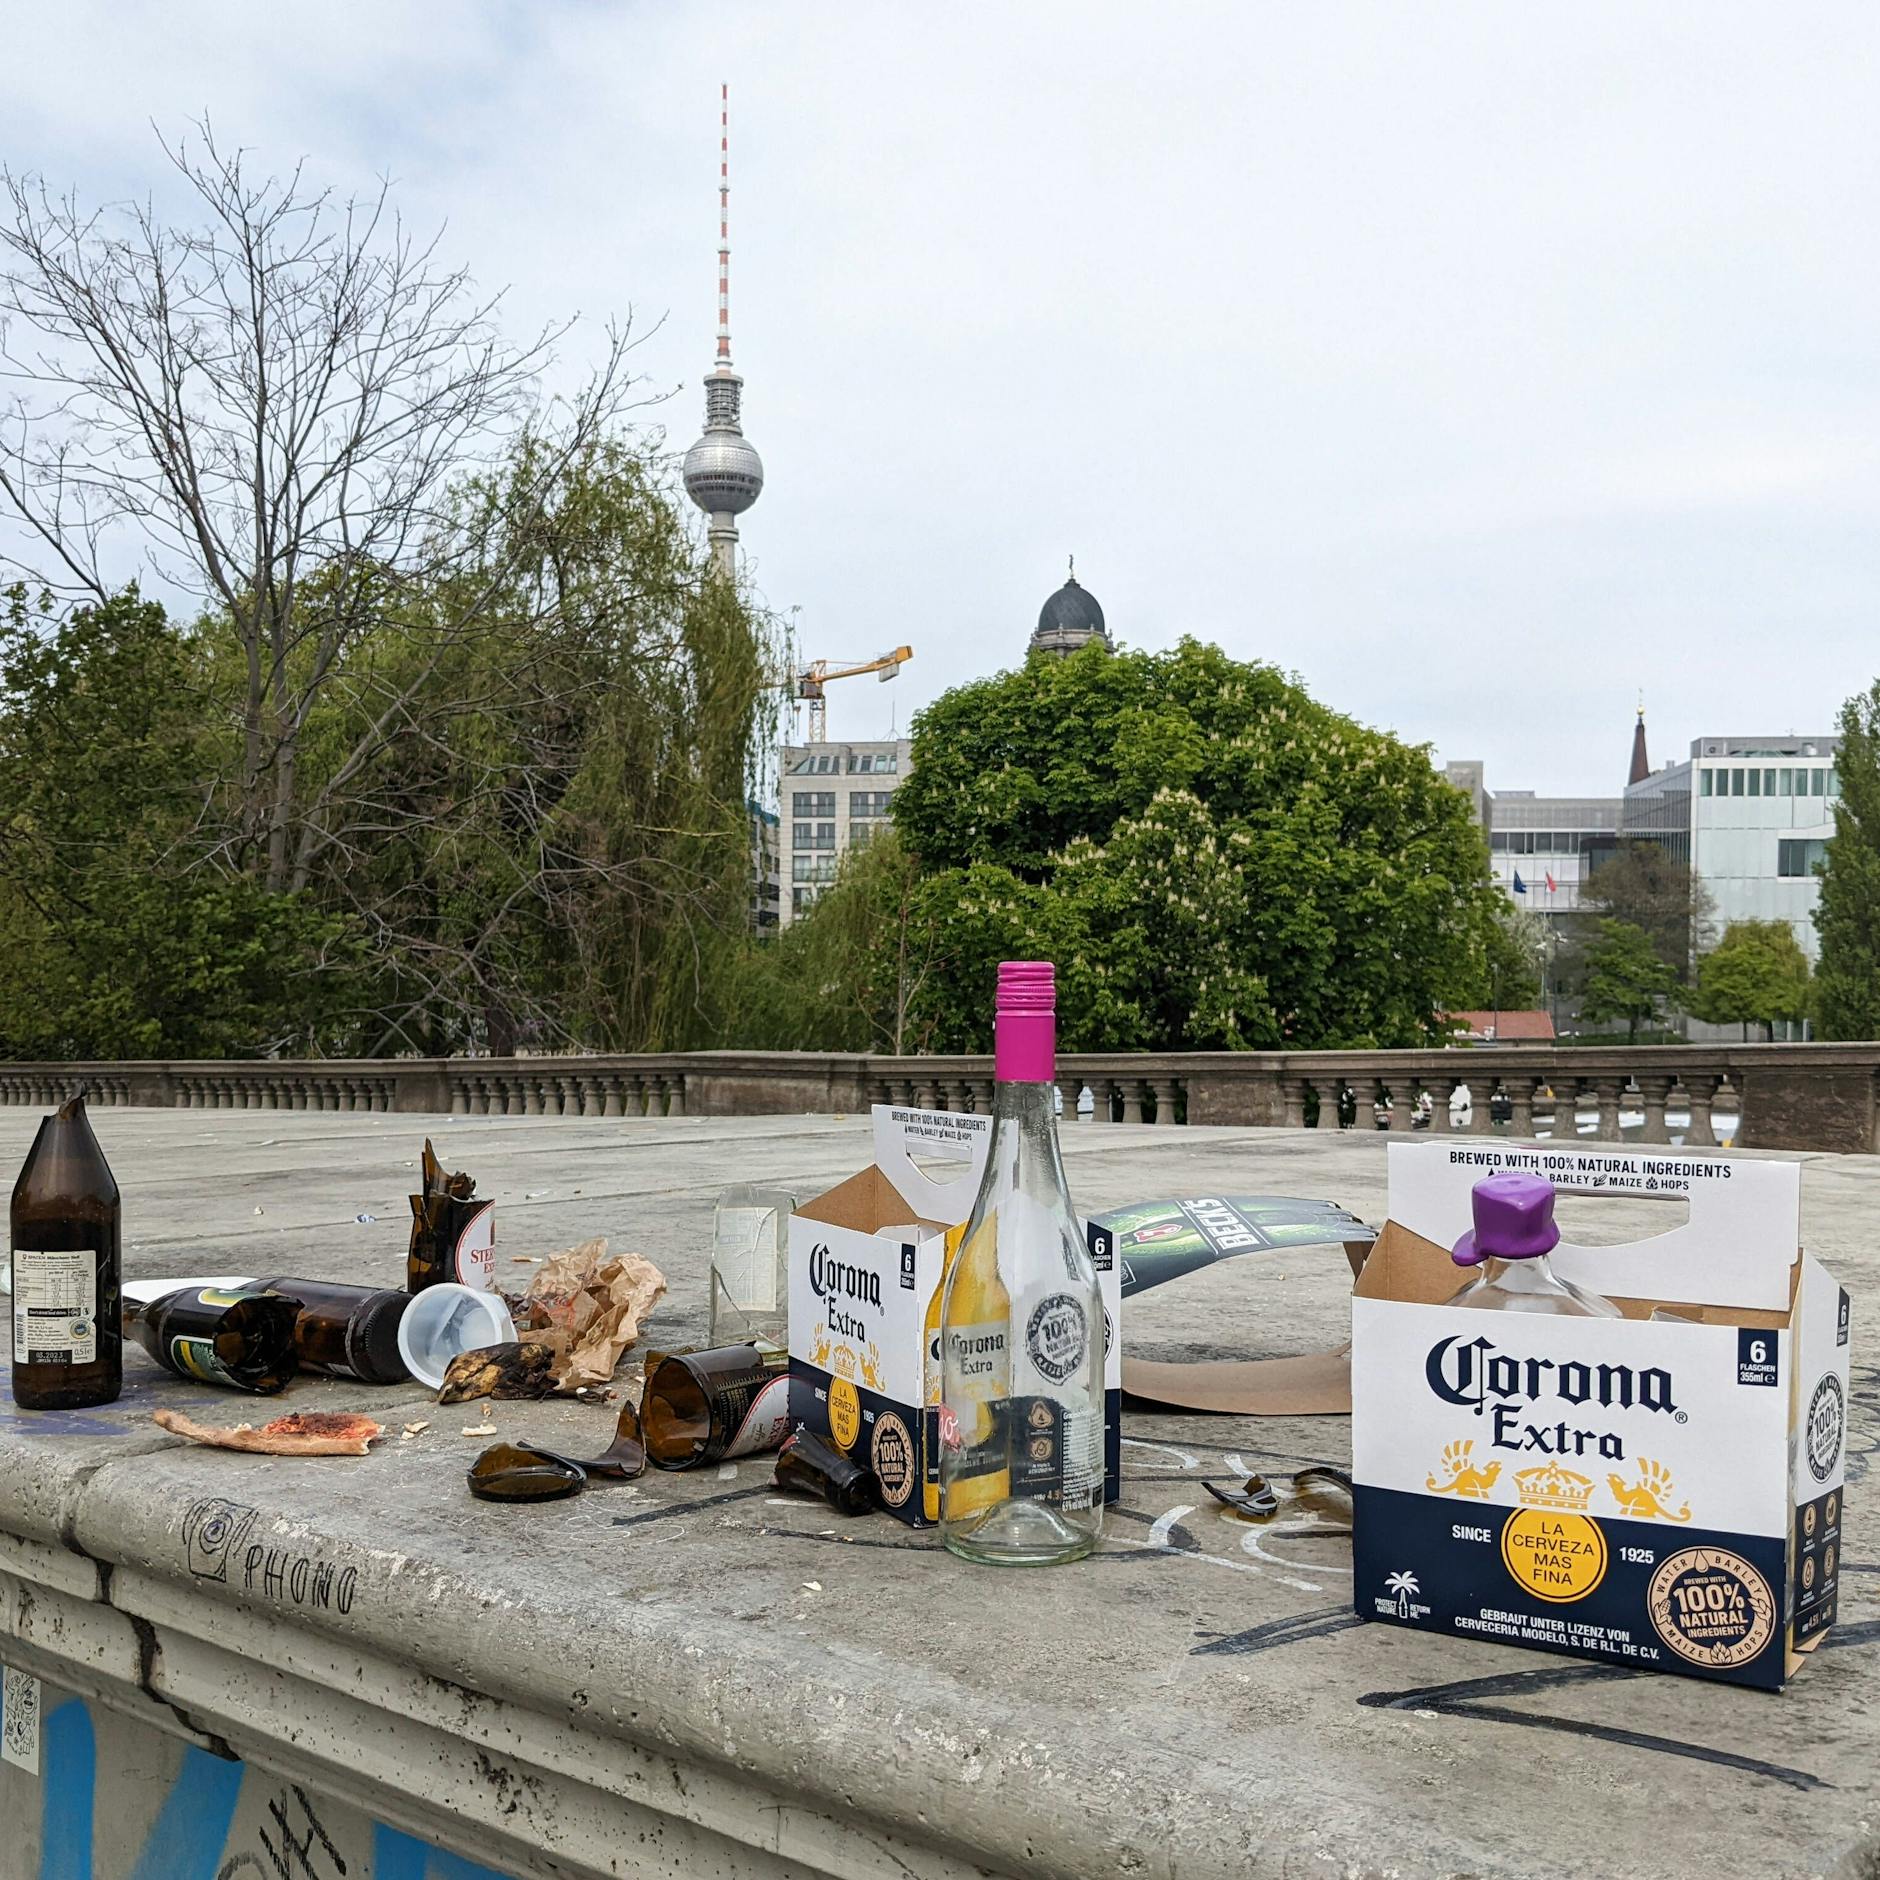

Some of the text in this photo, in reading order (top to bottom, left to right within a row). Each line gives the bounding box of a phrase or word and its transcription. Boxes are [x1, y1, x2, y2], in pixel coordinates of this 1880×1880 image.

[892, 1111, 908, 1122] BREWED
[1450, 1151, 1731, 1178] BREWED WITH 100% NATURAL INGREDIENTS
[1549, 1173, 1689, 1190] BARLEY MAIZE HOPS
[1095, 1237, 1106, 1255] 6
[905, 1253, 912, 1272] 6
[809, 1243, 881, 1308] Corona
[828, 1295, 865, 1343] Extra
[1841, 1305, 1847, 1325] 6
[1750, 1340, 1767, 1364] 6
[960, 1357, 993, 1376] Extra
[1426, 1335, 1679, 1416] Corona
[1740, 1363, 1776, 1373] FLASCHEN
[1740, 1371, 1763, 1382] 355ml
[814, 1387, 827, 1402] SINCE
[840, 1387, 848, 1398] LA
[831, 1396, 856, 1414] CERVEZA
[837, 1411, 850, 1425] MAS
[1814, 1401, 1836, 1438] 100%
[837, 1424, 849, 1436] FINA
[1491, 1404, 1626, 1460] Extra
[880, 1441, 904, 1462] 100%
[881, 1462, 905, 1475] NATURAL
[1452, 1524, 1492, 1543] SINCE
[1542, 1522, 1564, 1536] LA
[1512, 1534, 1595, 1556] CERVEZA
[1534, 1553, 1572, 1569] MAS
[1619, 1547, 1654, 1564] 1925
[245, 1545, 357, 1615] PHONO
[1533, 1569, 1573, 1586] FINA
[1656, 1558, 1688, 1593] WATER
[1715, 1556, 1762, 1594] BARLEY
[1375, 1598, 1397, 1607] PROTECT
[1673, 1583, 1745, 1613] 100%
[1410, 1604, 1431, 1614] RETURN
[1480, 1608, 1630, 1643] GEBRAUT UNTER LIZENZ VON
[1679, 1610, 1748, 1628] NATURAL
[1454, 1616, 1660, 1660] CERVECERIA MODELO, S. DE R.L. DE C.V.
[1688, 1626, 1745, 1638] INGREDIENTS
[1666, 1629, 1704, 1658] MAIZE
[1738, 1630, 1763, 1656] HOPS
